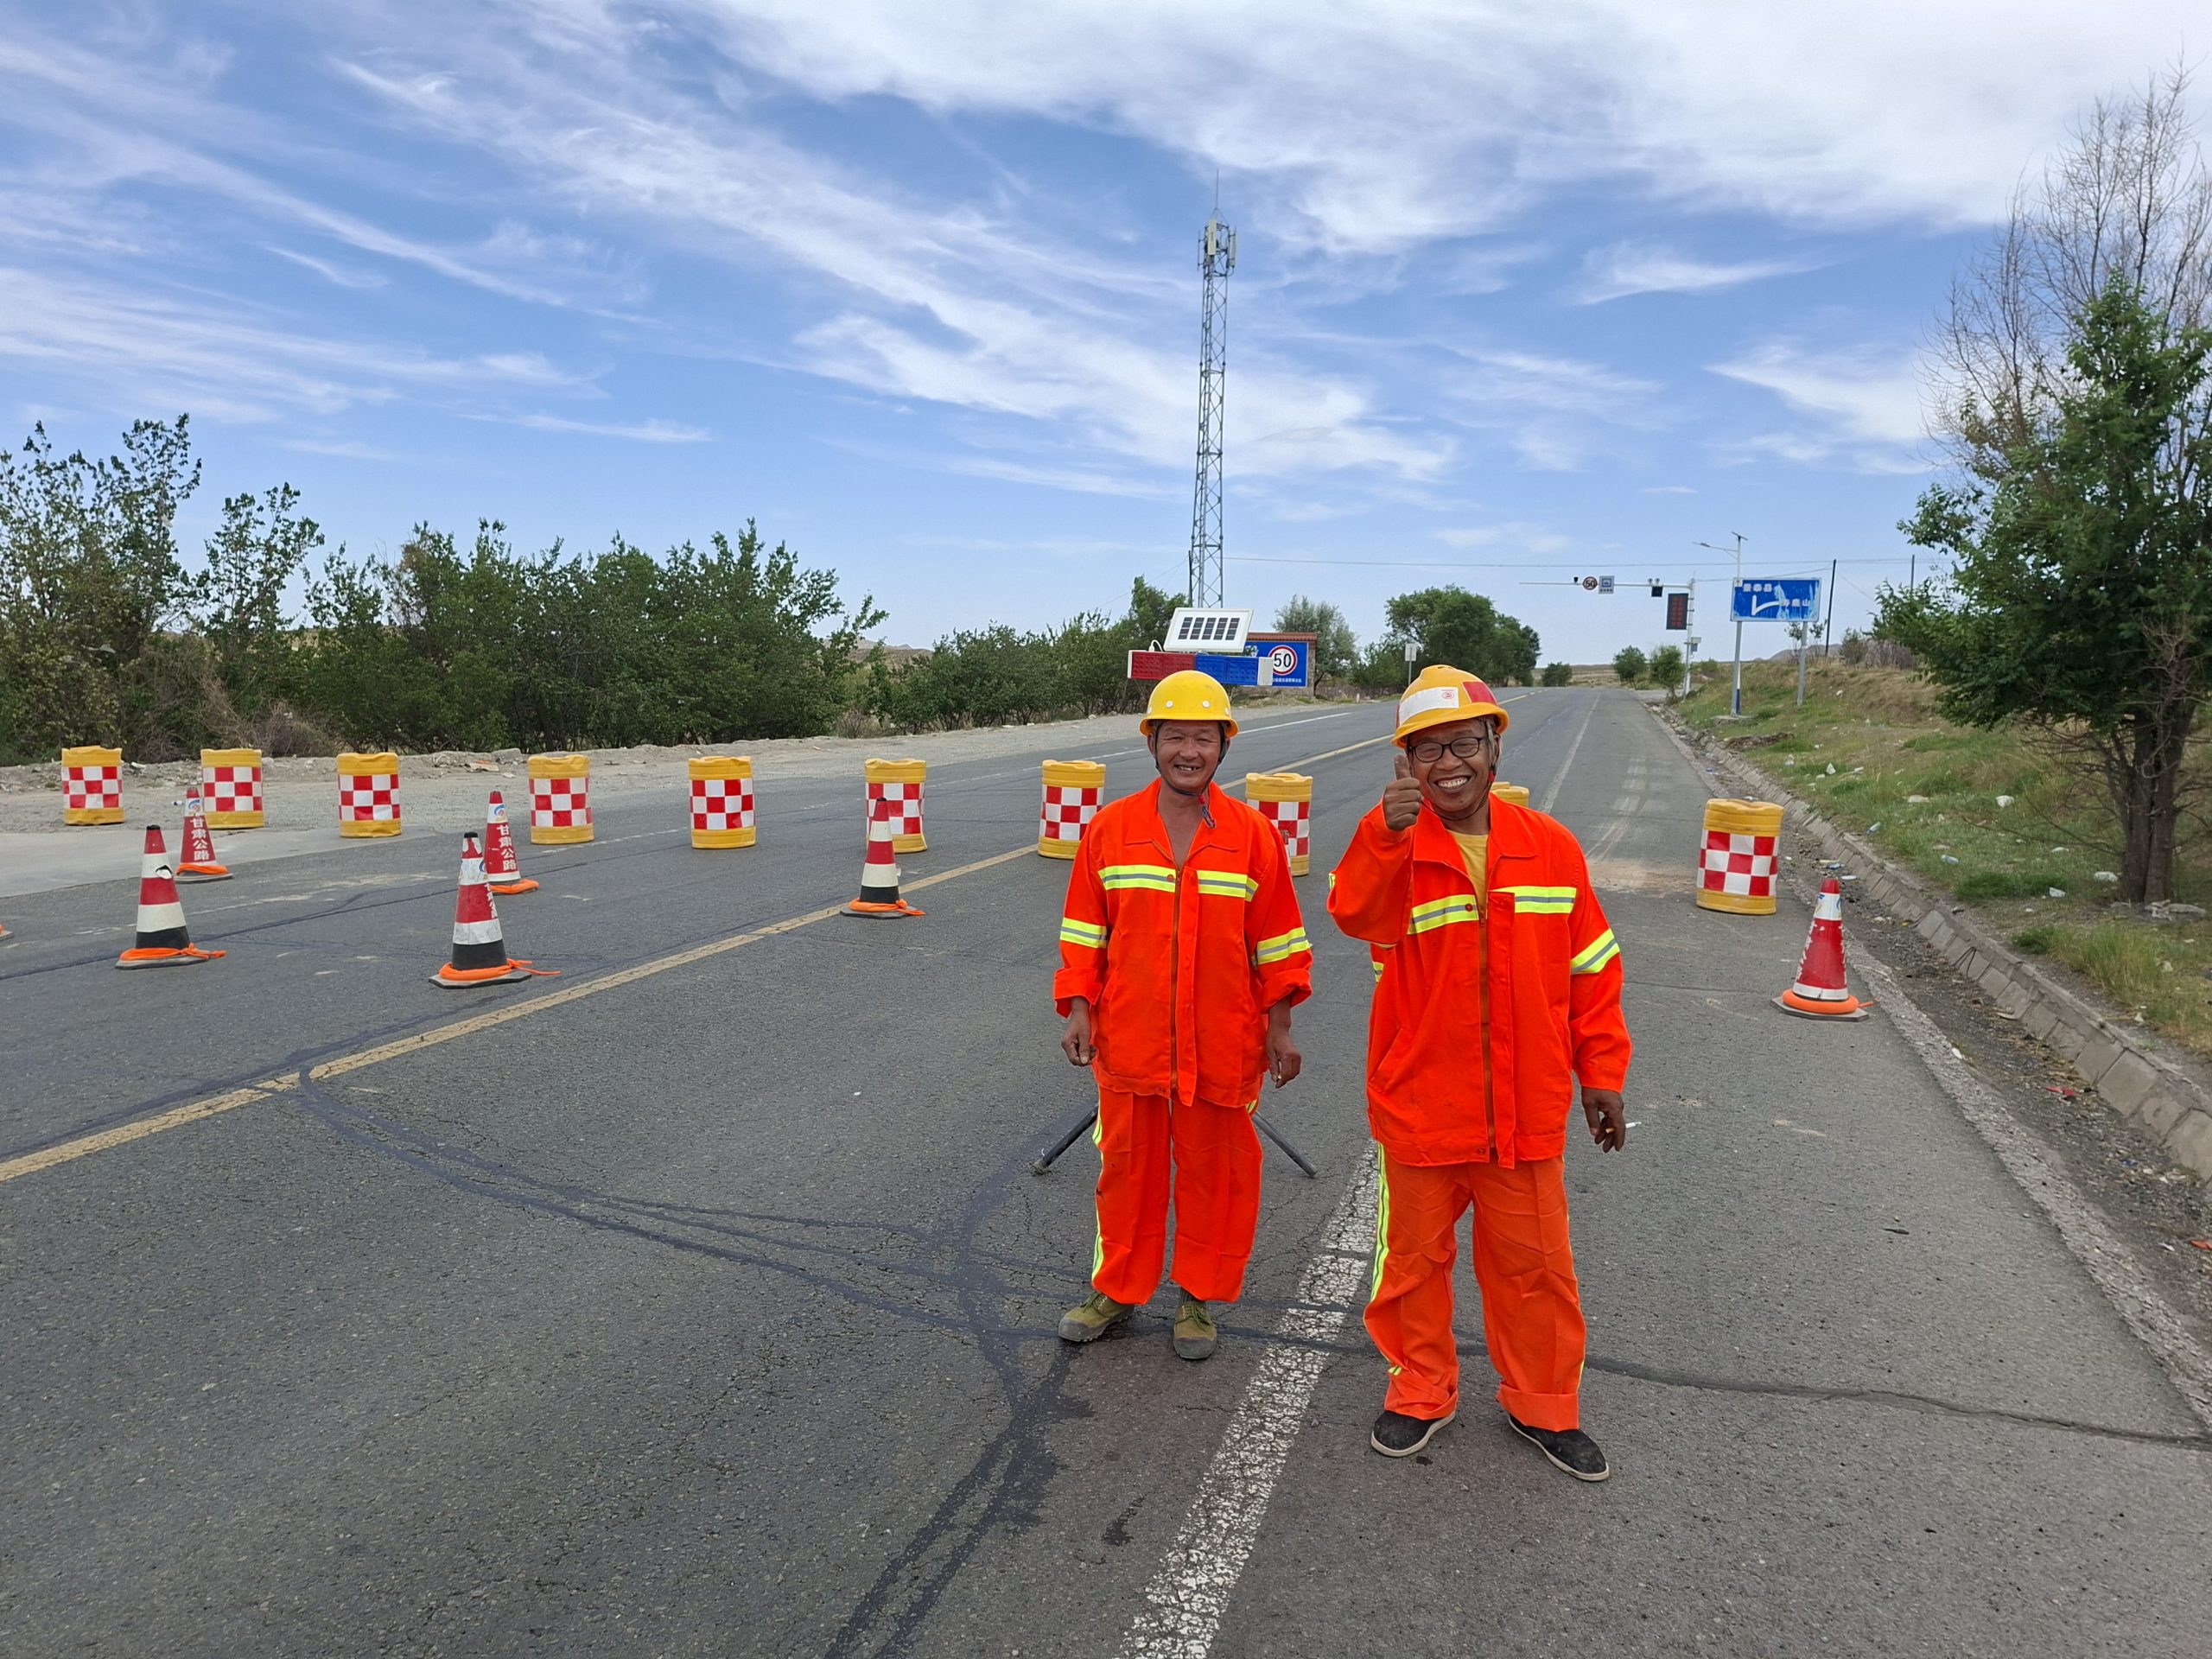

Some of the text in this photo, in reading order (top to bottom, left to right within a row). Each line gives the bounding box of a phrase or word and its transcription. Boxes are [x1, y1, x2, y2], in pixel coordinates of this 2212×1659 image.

[1274, 653, 1292, 668] 50
[190, 817, 209, 861] 甘肃公路
[497, 823, 517, 871] 甘肃公路
